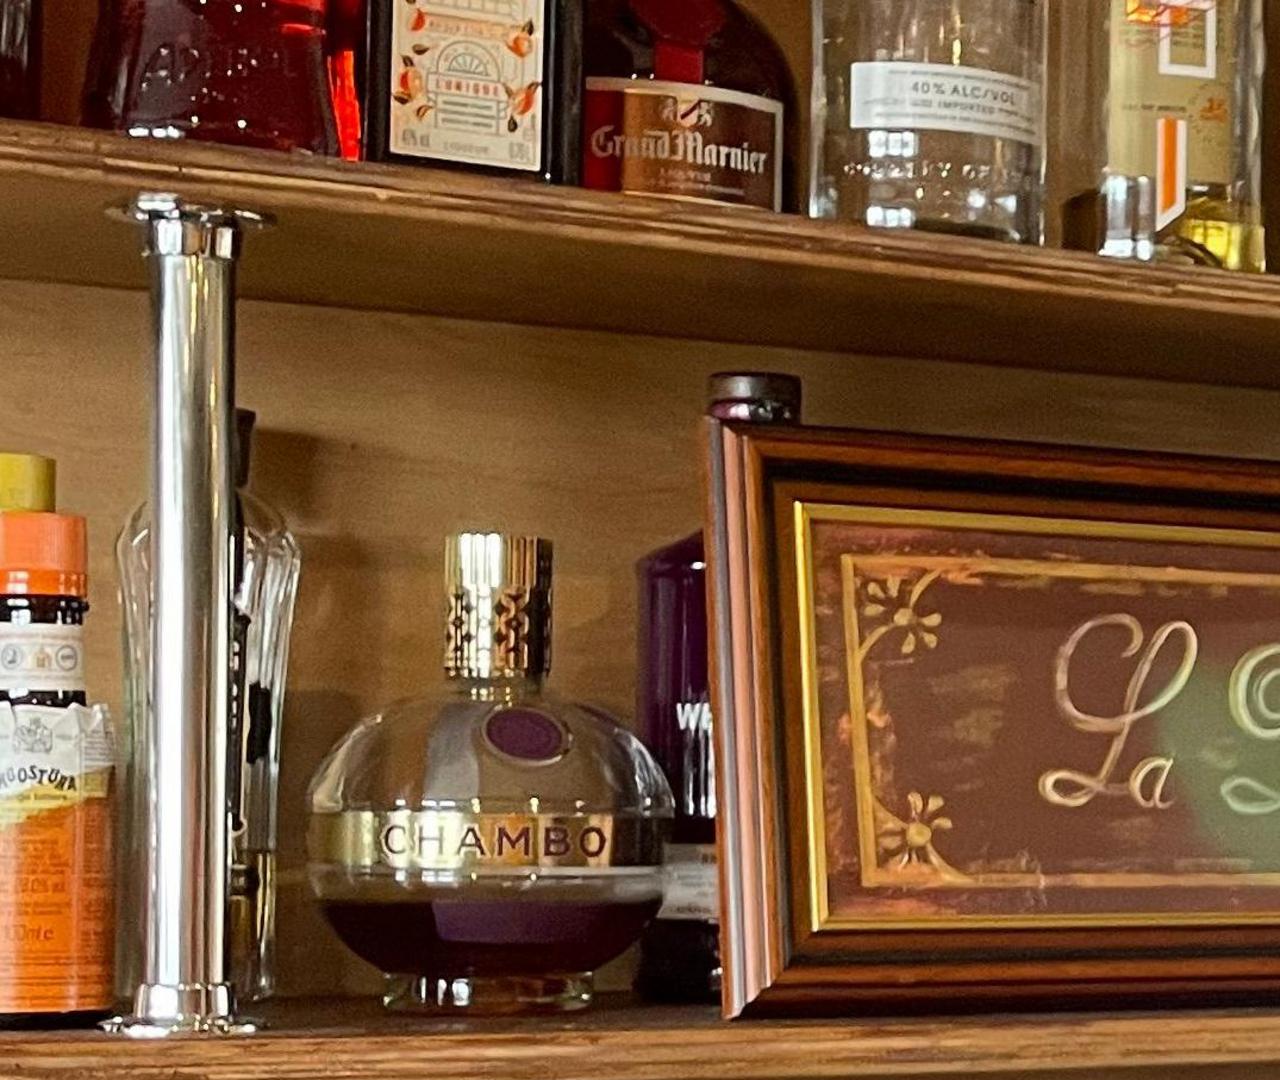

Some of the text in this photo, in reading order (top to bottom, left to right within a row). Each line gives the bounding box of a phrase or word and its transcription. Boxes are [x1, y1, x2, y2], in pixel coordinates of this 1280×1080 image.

[591, 125, 768, 174] Grand Marnier
[1038, 612, 1198, 809] La
[383, 823, 607, 859] CHAMBO
